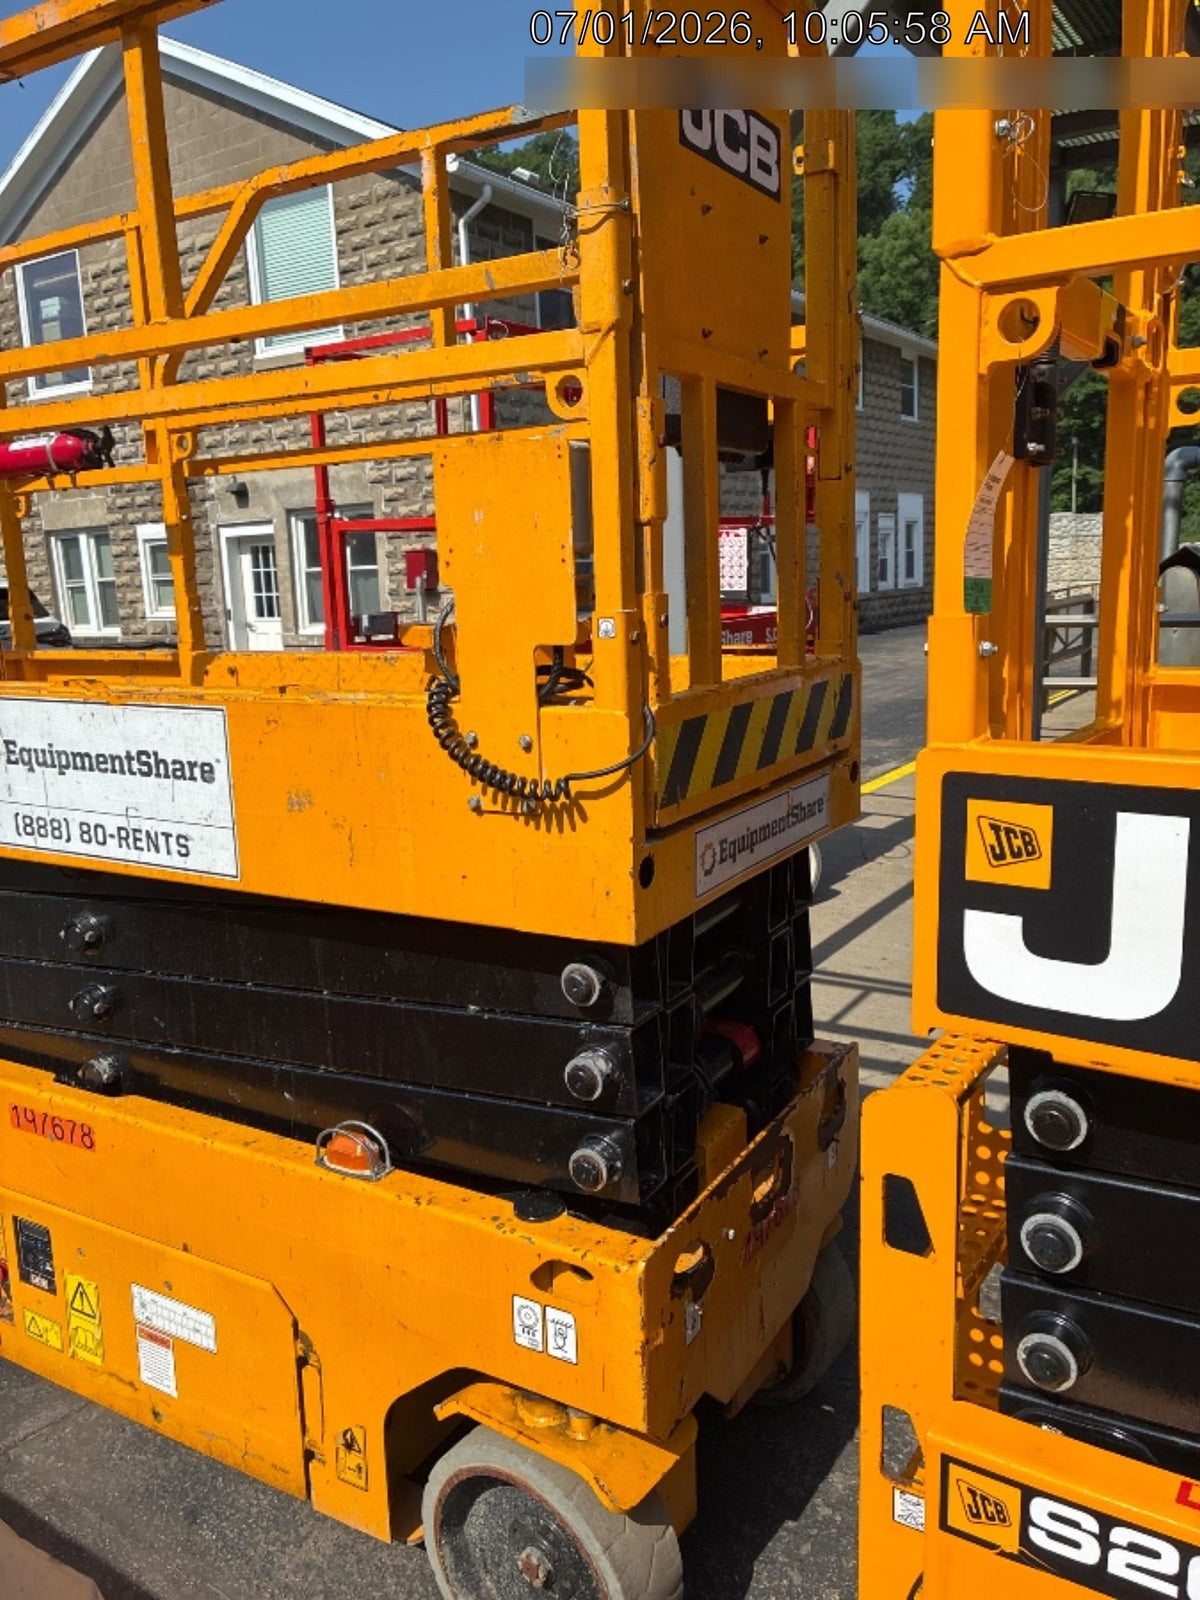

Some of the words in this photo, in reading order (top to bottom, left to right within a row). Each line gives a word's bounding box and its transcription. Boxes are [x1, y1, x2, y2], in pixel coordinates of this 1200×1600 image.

[682, 110, 779, 193] JCB
[3, 739, 216, 784] EquipmentShare
[15, 812, 72, 843] (888)
[79, 821, 192, 858] 80-RENTS
[719, 797, 824, 865] EquipmentShare
[988, 822, 1038, 862] JCB
[963, 811, 1190, 1021] J
[966, 1486, 1008, 1525] JCB
[1028, 1496, 1200, 1600] S2
